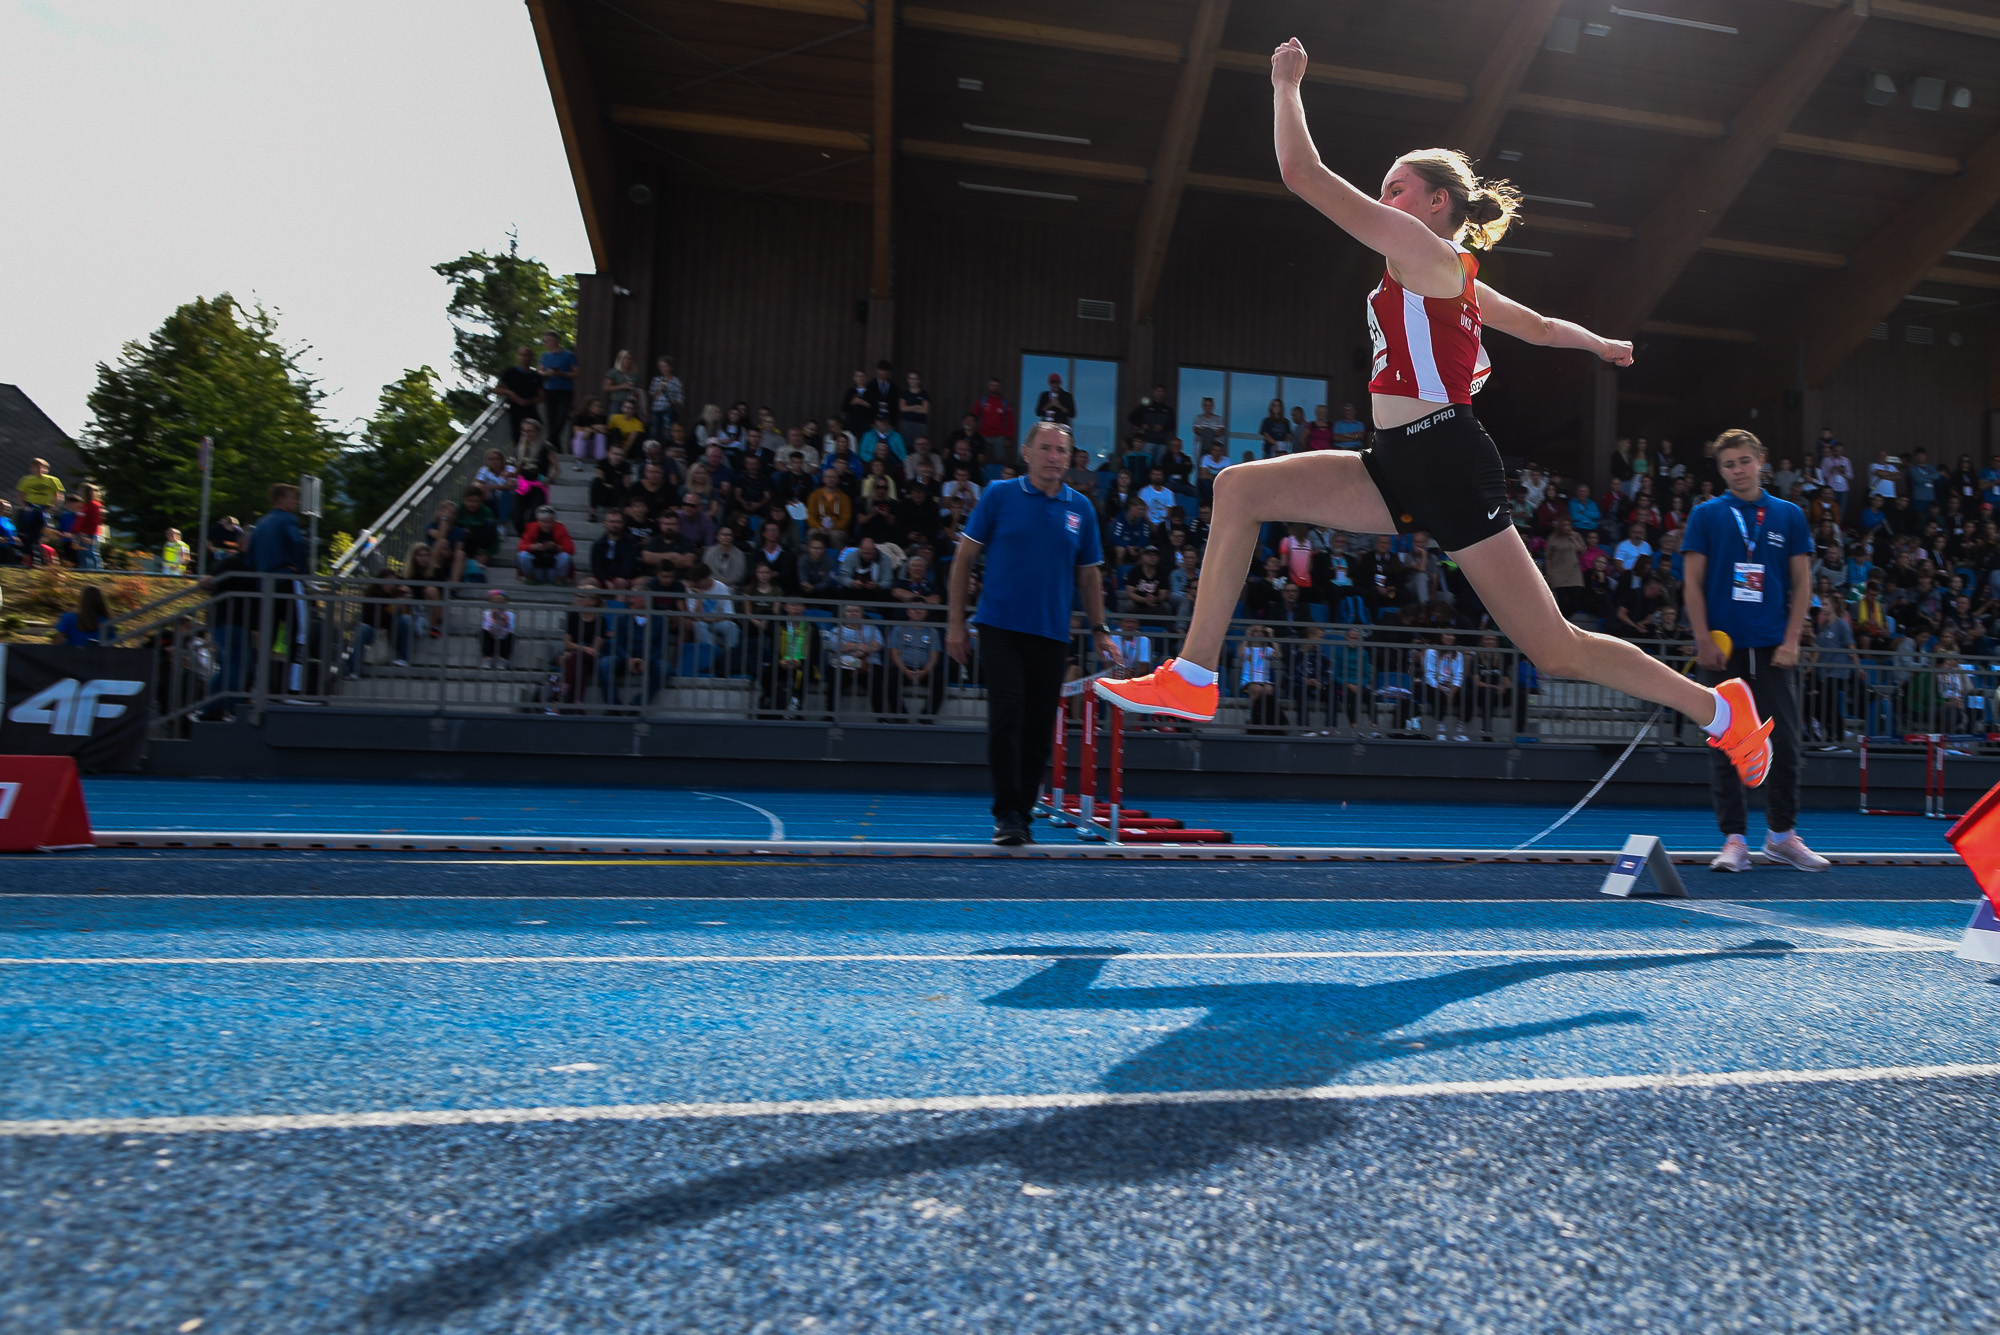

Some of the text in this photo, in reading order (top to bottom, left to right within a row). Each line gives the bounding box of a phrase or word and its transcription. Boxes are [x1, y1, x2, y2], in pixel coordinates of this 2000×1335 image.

[1406, 408, 1456, 436] NIKE PRO
[8, 678, 146, 736] 4F
